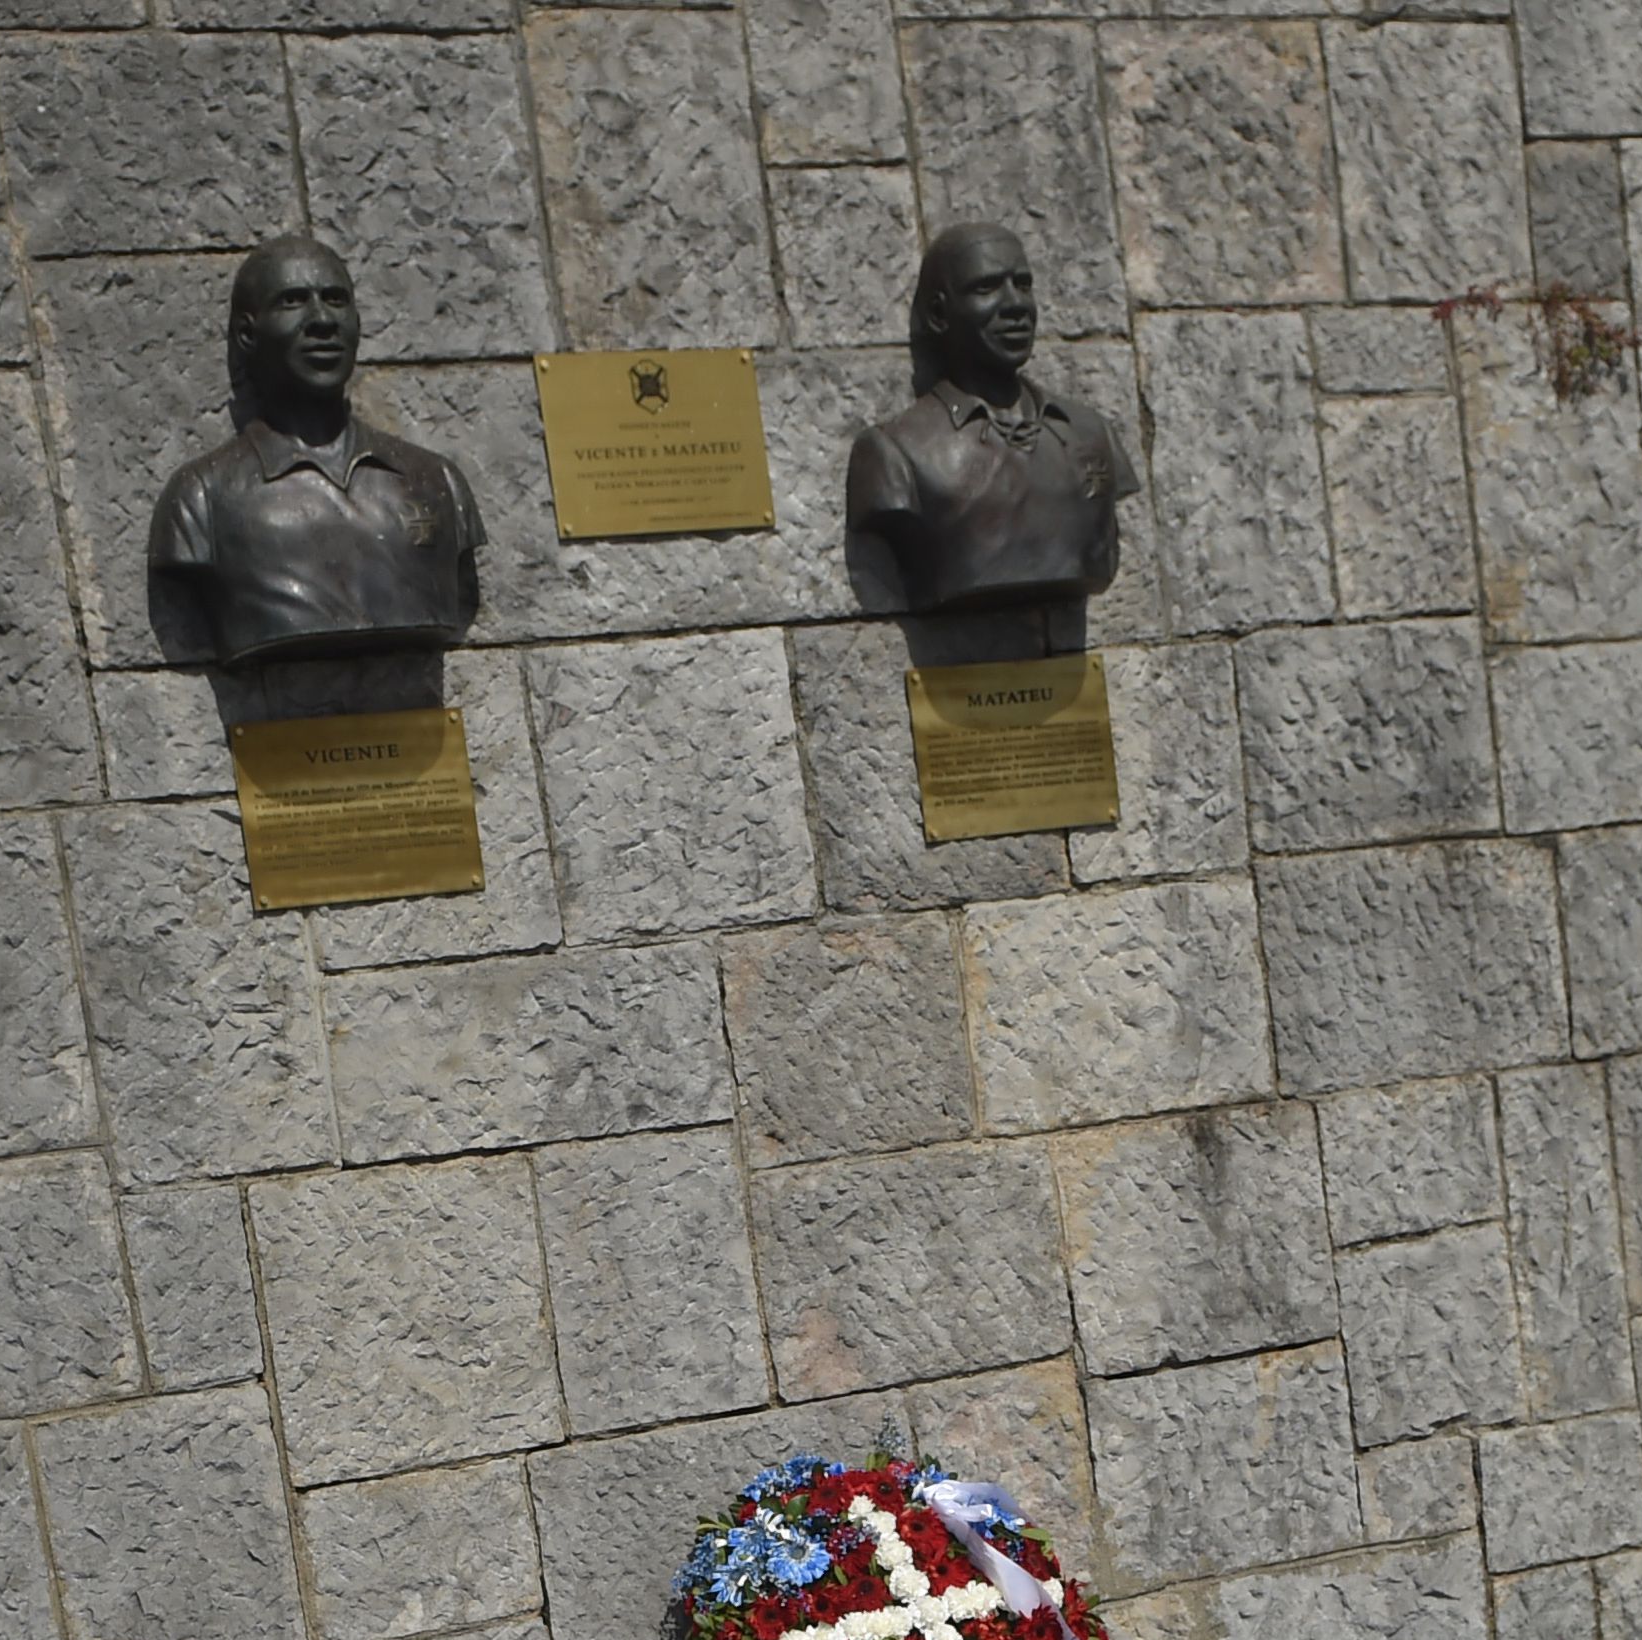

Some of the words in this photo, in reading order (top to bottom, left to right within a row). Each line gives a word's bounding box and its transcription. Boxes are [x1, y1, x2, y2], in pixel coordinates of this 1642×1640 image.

[575, 446, 646, 461] VICENTE
[663, 441, 742, 458] MATATEU
[968, 688, 1053, 708] MATATEU
[305, 744, 399, 764] VICENTE
